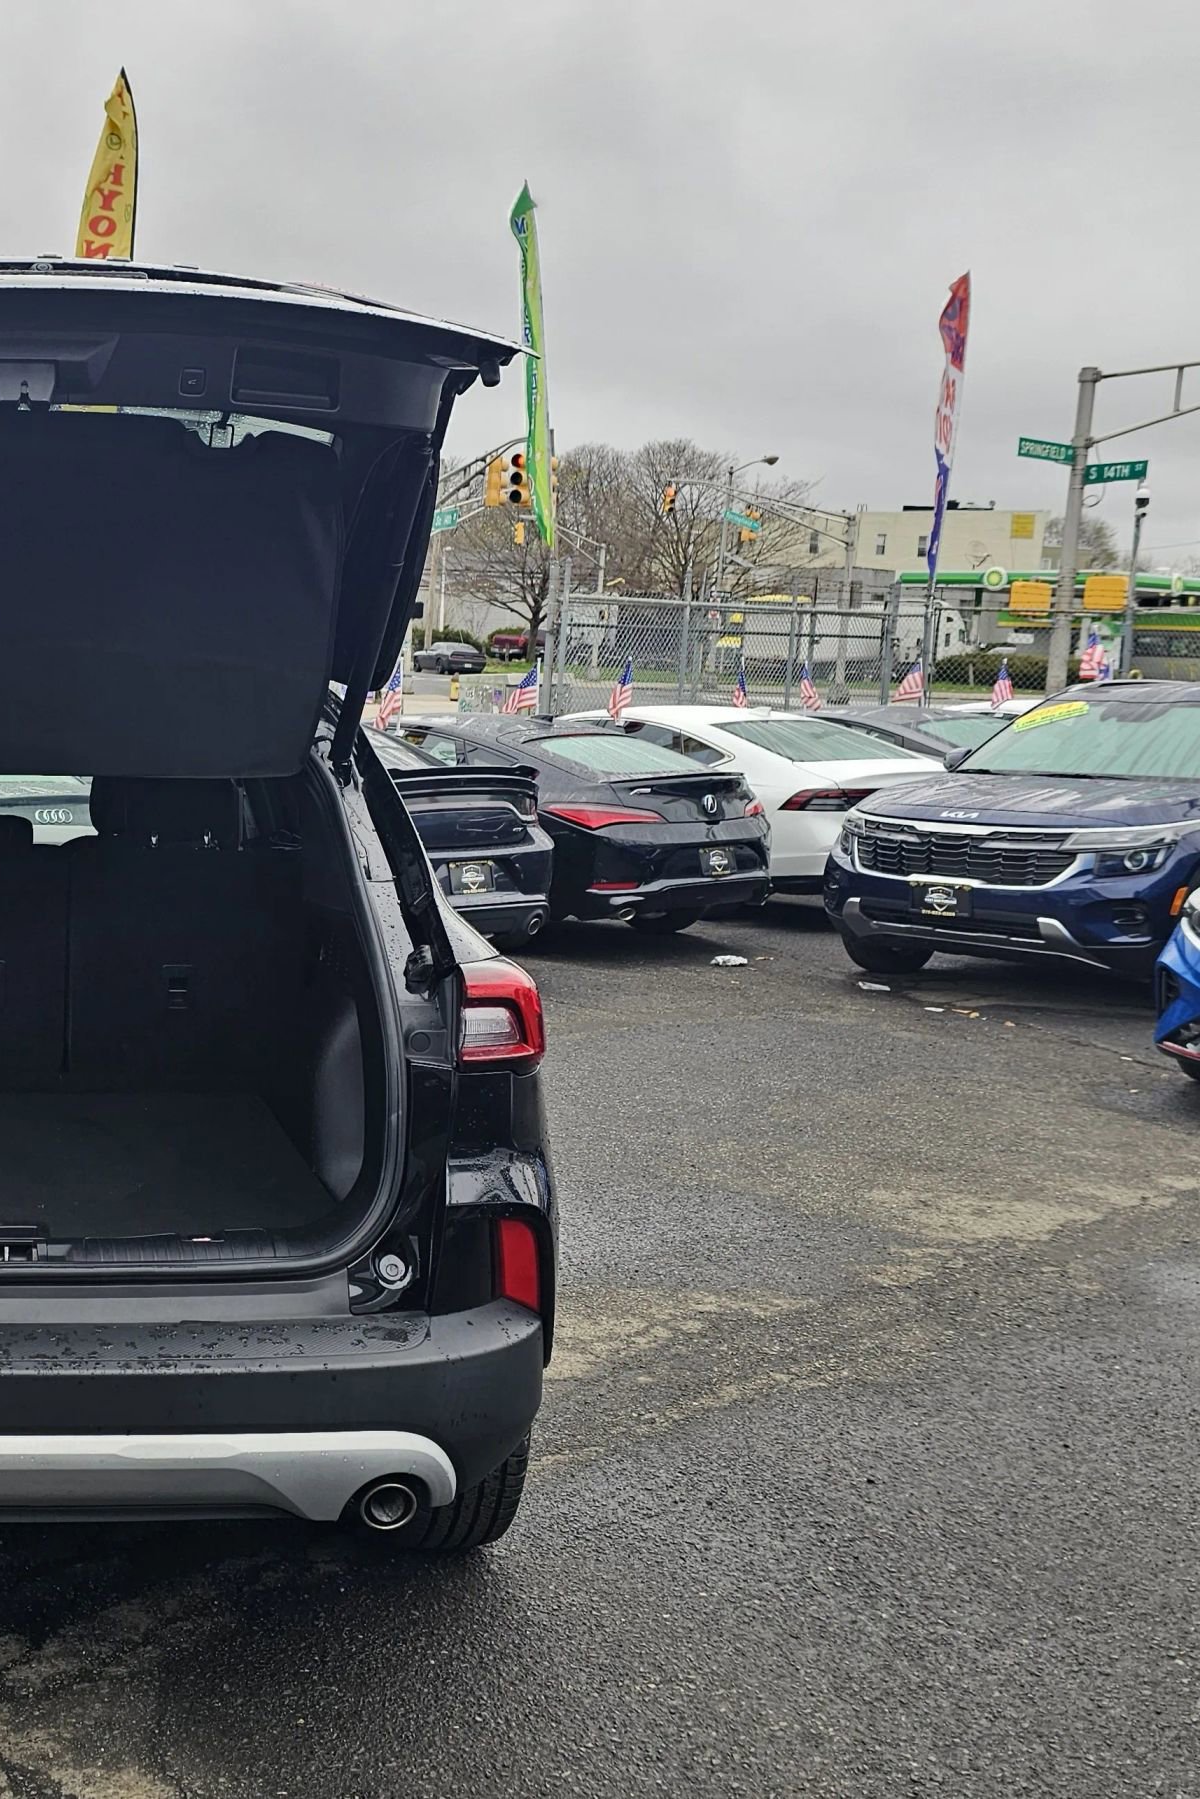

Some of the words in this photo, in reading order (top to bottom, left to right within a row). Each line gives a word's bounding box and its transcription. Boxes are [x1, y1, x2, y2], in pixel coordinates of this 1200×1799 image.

[1020, 441, 1066, 460] SPRINGFIELD
[1089, 467, 1098, 480] S
[1103, 464, 1131, 478] 14TH
[1134, 463, 1145, 471] ST
[940, 811, 980, 819] KIA
